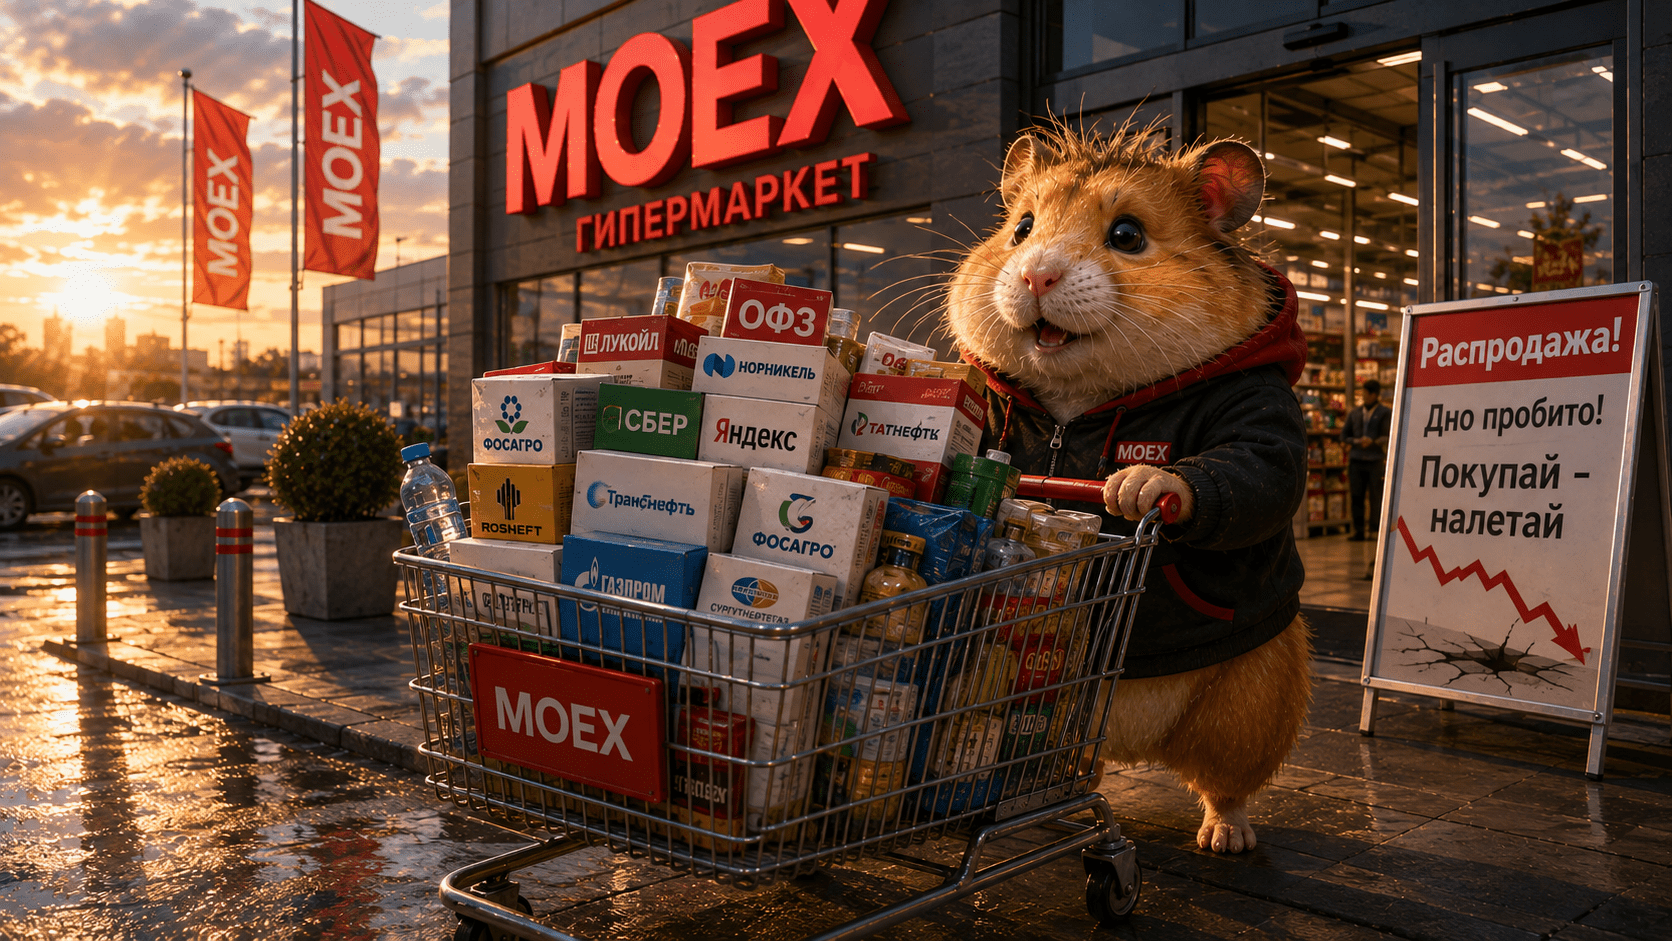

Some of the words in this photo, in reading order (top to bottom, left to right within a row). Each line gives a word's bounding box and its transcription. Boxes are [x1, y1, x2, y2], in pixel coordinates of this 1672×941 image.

[506, 0, 905, 215] MOEX
[321, 69, 363, 240] MOEX
[206, 148, 239, 278] MOEX
[576, 152, 877, 253] ГИПЕРМАРКЕТ
[738, 299, 816, 338] ОФЗ
[600, 328, 659, 352] ЛУКОЙЛ
[1420, 316, 1623, 371] Распродажа!
[738, 360, 816, 380] НОРНИКЕЛЬ
[625, 409, 688, 436] СБЕР
[1423, 403, 1475, 437] Дно
[1482, 394, 1604, 437] пробито!
[483, 438, 543, 452] ФОСАГРО
[713, 417, 798, 452] Яндекс
[1117, 444, 1168, 461] MOEX
[1419, 453, 1562, 498] Покупай
[1430, 503, 1564, 539] налетай
[752, 531, 834, 559] ФОСАГРО
[601, 574, 666, 604] ГАЗПРОМ
[494, 686, 634, 763] MOEX
